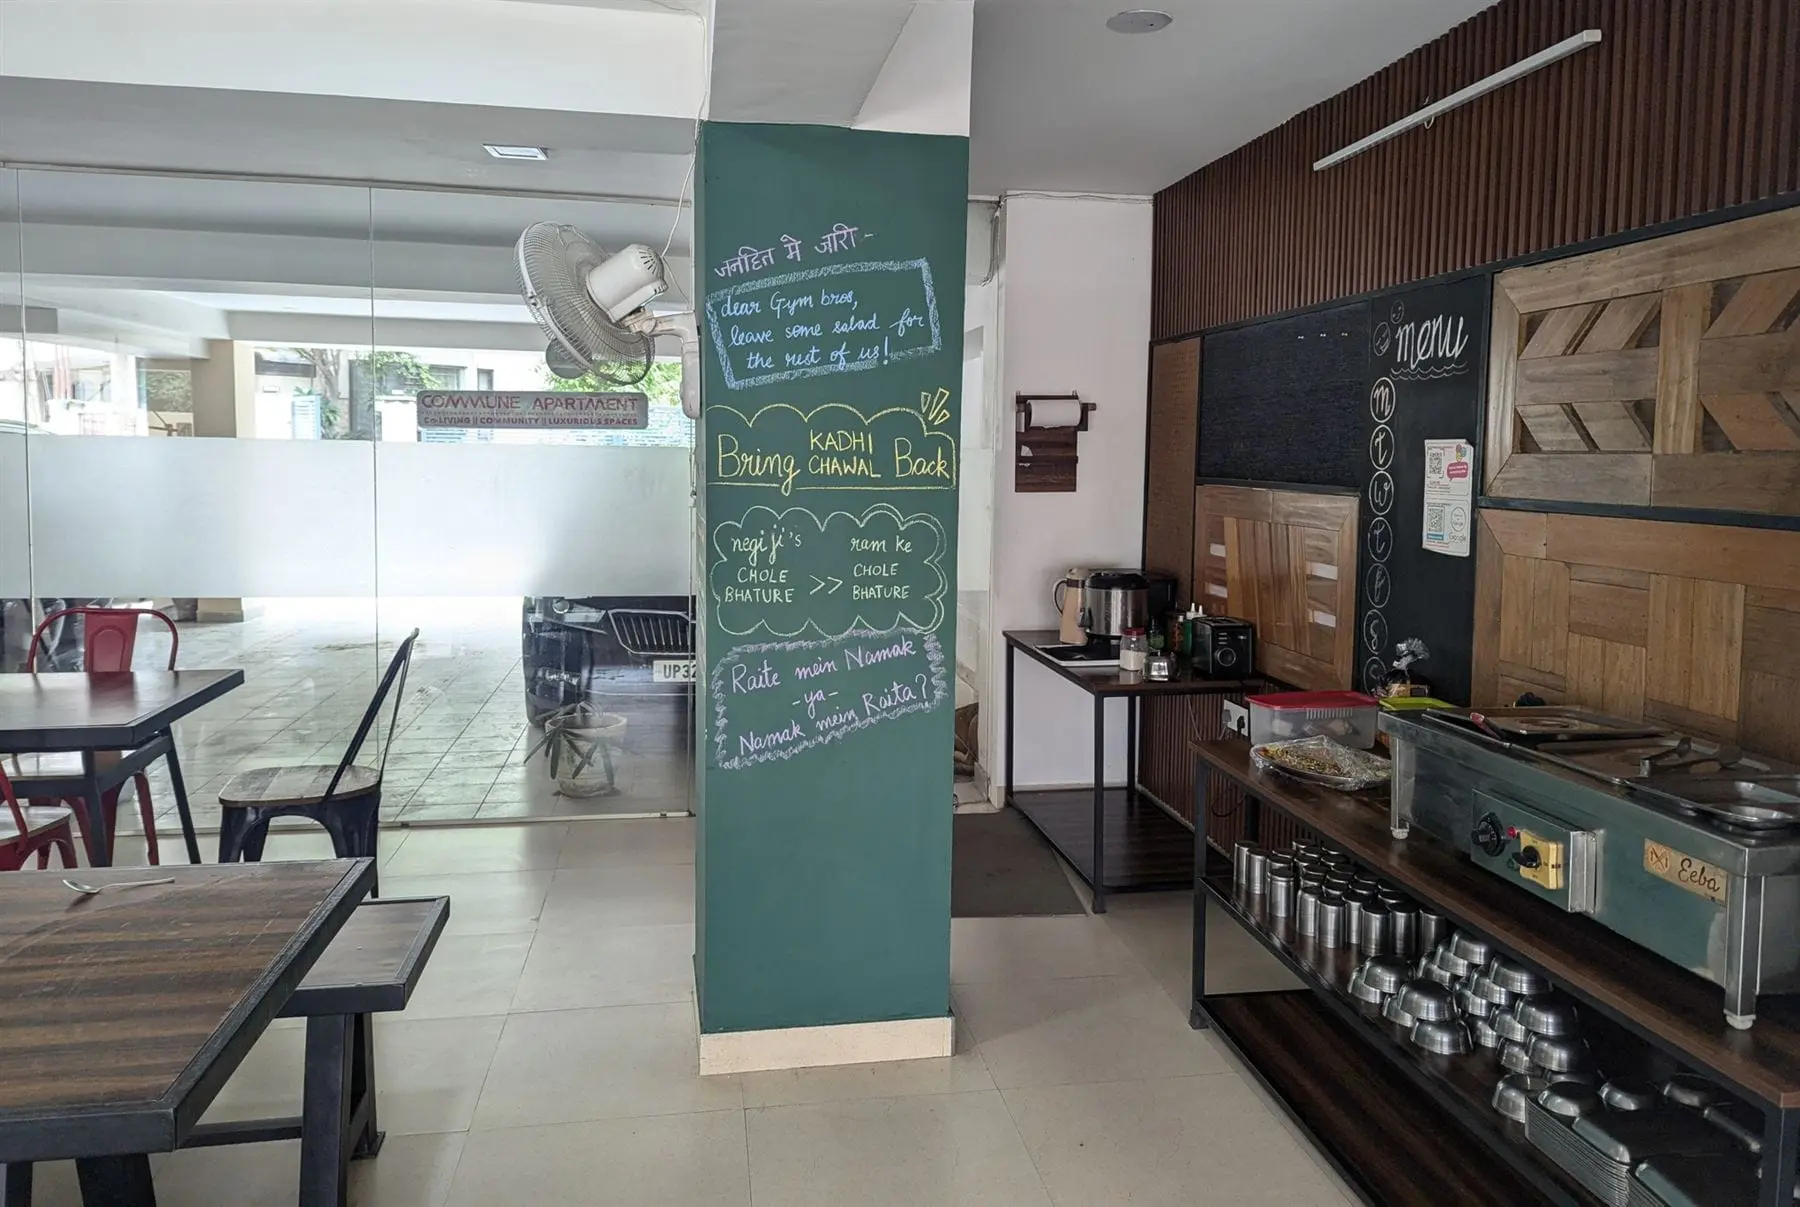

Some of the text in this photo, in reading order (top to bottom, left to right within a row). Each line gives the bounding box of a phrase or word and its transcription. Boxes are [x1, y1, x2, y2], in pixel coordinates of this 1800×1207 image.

[721, 288, 859, 320] dear Gym bros,
[727, 307, 925, 349] leave some salad for
[1395, 313, 1469, 370] menu
[746, 336, 889, 370] the rest of us!
[422, 394, 638, 411] COMMUNE APARTMENT
[480, 416, 540, 425] COMMUNITY
[603, 418, 638, 426] SPACES
[717, 429, 950, 497] Bring KADHI CHAWAL Back
[850, 538, 888, 553] ram
[737, 565, 788, 584] CHOLE
[853, 562, 899, 577] CHOLE
[725, 584, 911, 604] BHATURE BHATURE
[731, 635, 917, 694] Raite mein Namak
[739, 673, 928, 755] Namak mein Raita?
[1677, 857, 1721, 893] Eeba
